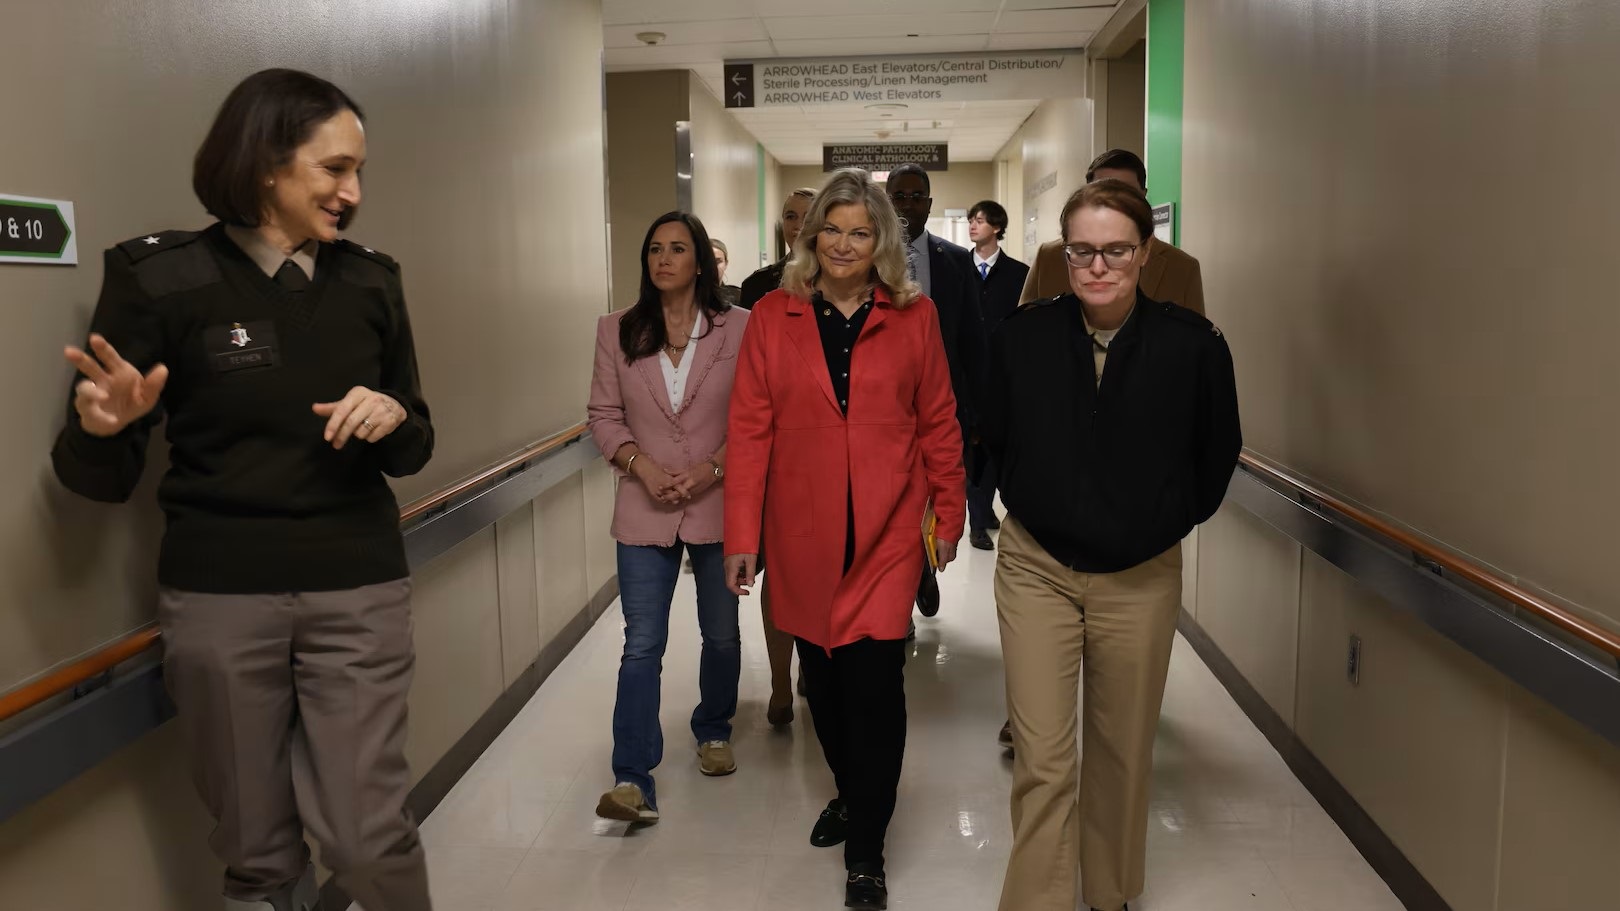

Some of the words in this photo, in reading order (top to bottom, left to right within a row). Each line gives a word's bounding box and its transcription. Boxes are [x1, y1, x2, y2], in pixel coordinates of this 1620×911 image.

[763, 65, 849, 77] ARROWHEAD
[852, 64, 878, 74] East
[882, 60, 985, 73] Elevators/Central
[988, 57, 1065, 70] Distribution/
[763, 78, 800, 89] Sterile
[804, 74, 906, 88] Processing/Linen
[910, 73, 988, 85] Management
[764, 91, 849, 103] ARROWHEAD
[854, 90, 882, 100] West
[887, 89, 942, 99] Elevators
[832, 146, 880, 154] ANATOMIC
[882, 145, 939, 154] PATHOLOGY,
[832, 155, 874, 163] CLINICAL
[875, 154, 931, 162] PATHOLOGY,
[8, 217, 20, 238] &
[25, 219, 43, 240] 10
